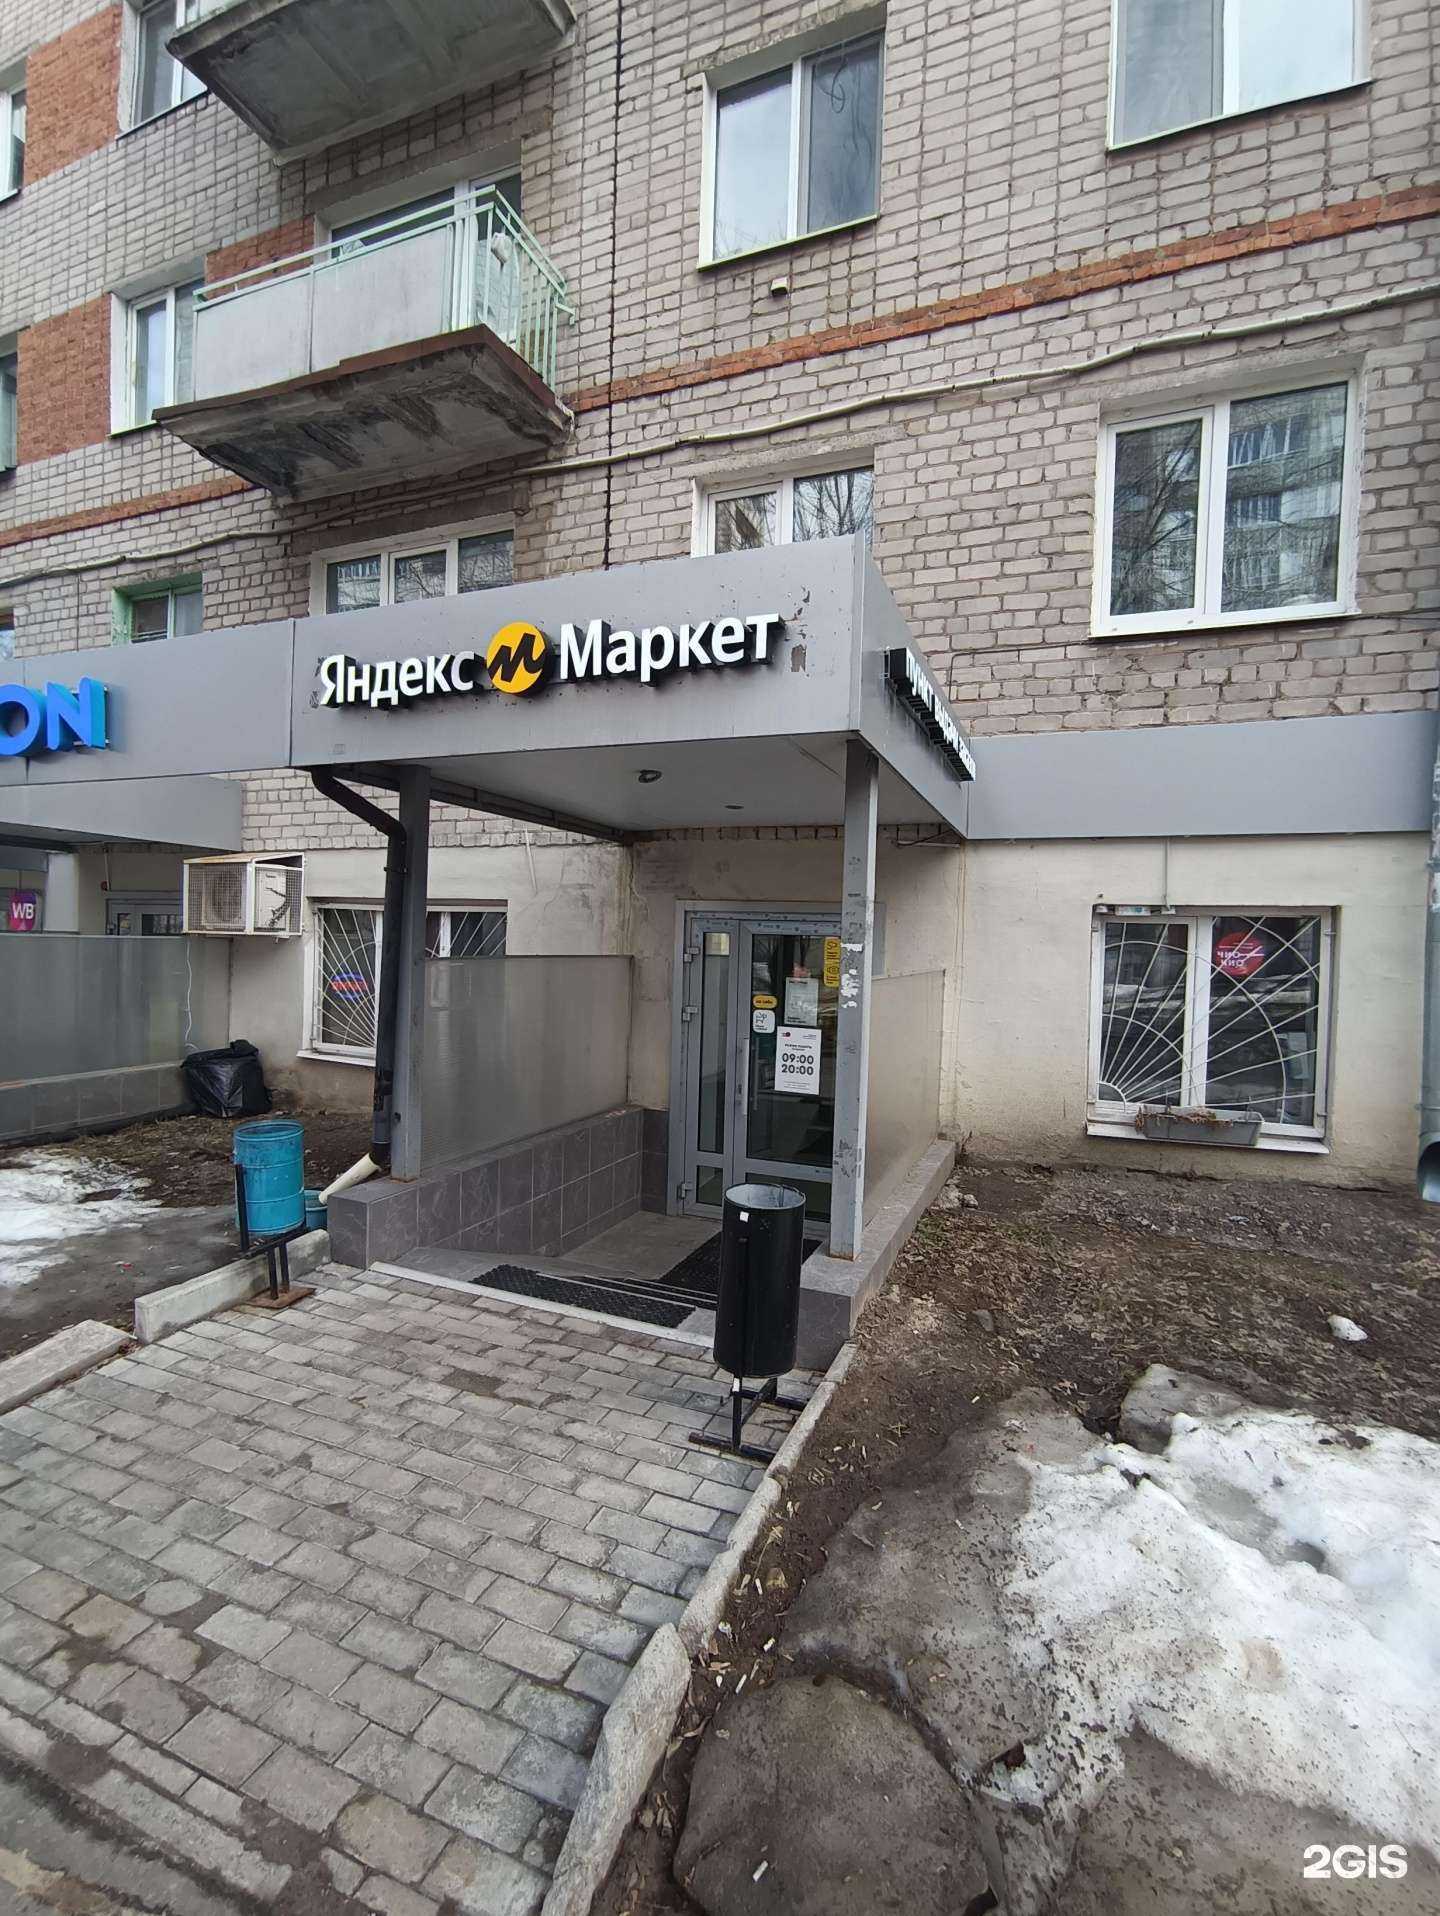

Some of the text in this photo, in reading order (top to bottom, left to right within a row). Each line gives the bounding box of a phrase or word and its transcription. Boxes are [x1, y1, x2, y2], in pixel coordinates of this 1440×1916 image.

[319, 651, 475, 708] Яндекс
[560, 614, 780, 682] Маркет
[12, 902, 34, 919] WB
[782, 1053, 814, 1065] 09:00
[781, 1064, 814, 1076] 20:00
